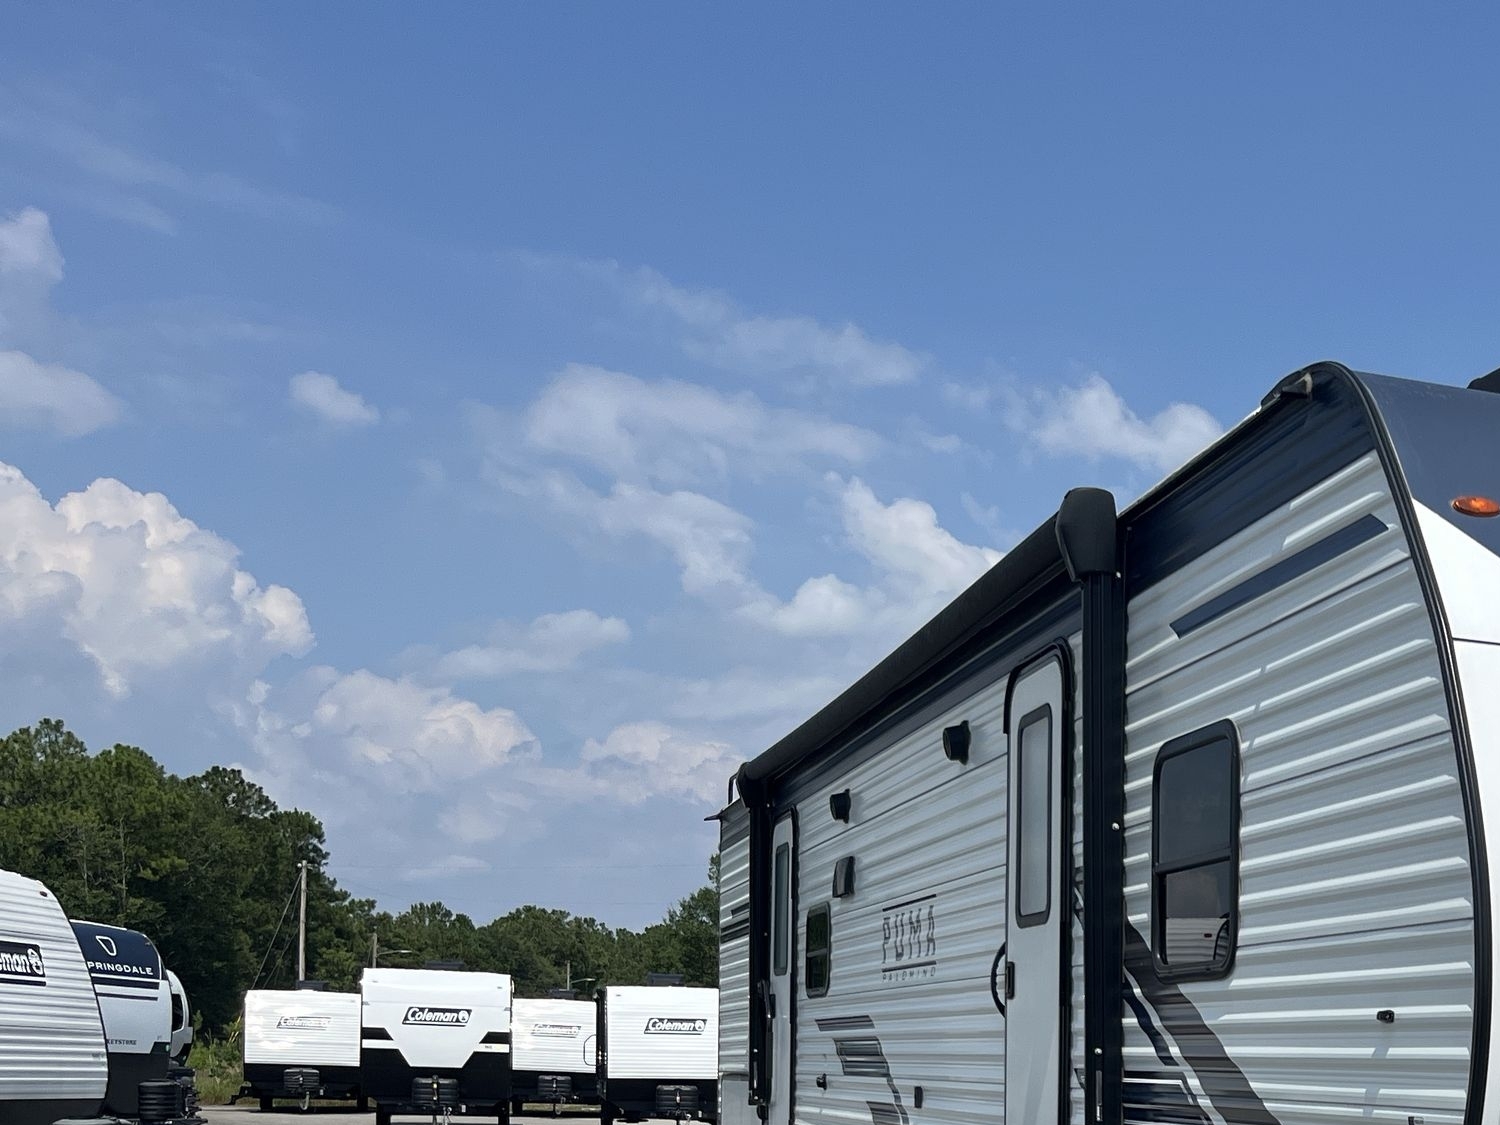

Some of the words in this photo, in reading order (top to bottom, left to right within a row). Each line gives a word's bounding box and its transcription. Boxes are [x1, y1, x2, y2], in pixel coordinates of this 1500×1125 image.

[882, 905, 936, 964] PUMA
[0, 952, 32, 974] man
[86, 961, 154, 976] PRINGDALE
[407, 1006, 457, 1023] Coleman
[647, 1018, 694, 1032] Coleman
